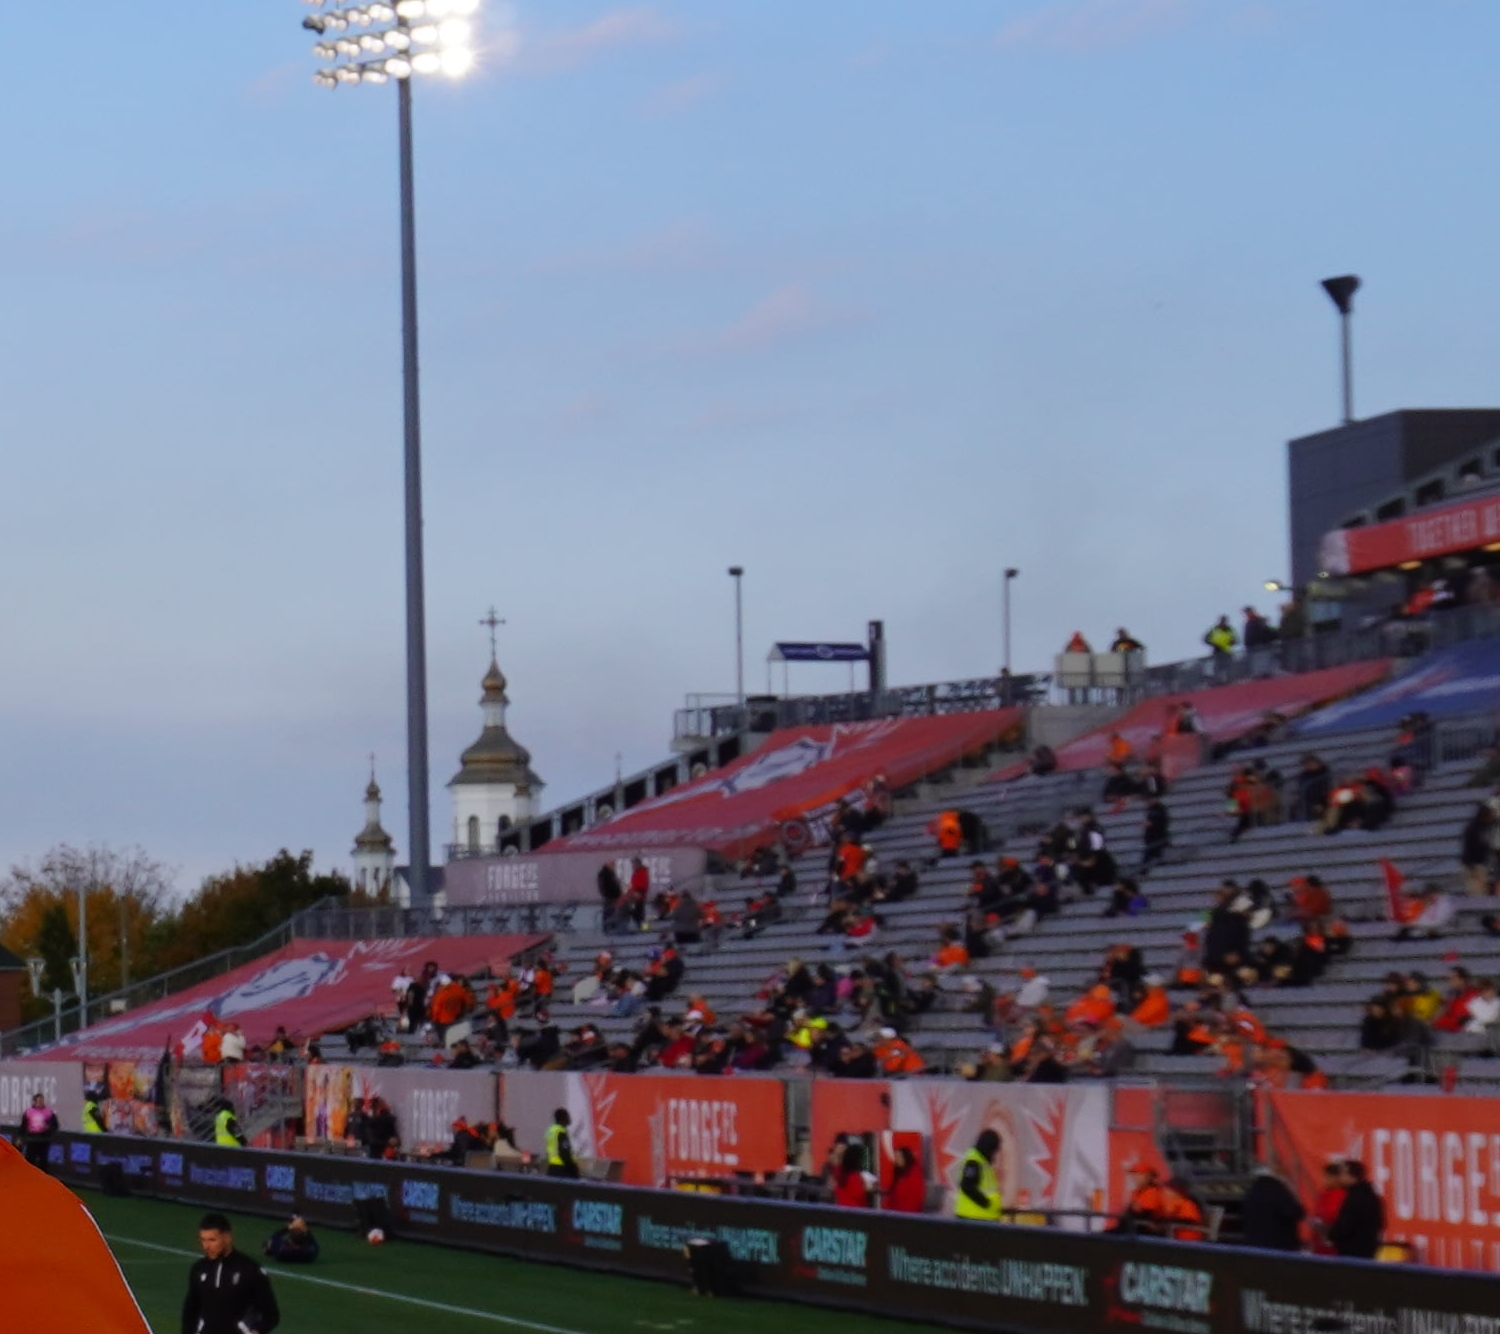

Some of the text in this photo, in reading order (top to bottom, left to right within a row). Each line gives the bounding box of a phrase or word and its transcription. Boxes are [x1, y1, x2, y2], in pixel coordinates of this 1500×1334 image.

[1372, 1127, 1488, 1226] FORGE
[801, 1225, 869, 1269] CARSTAR
[1120, 1261, 1214, 1315] CARSTAR
